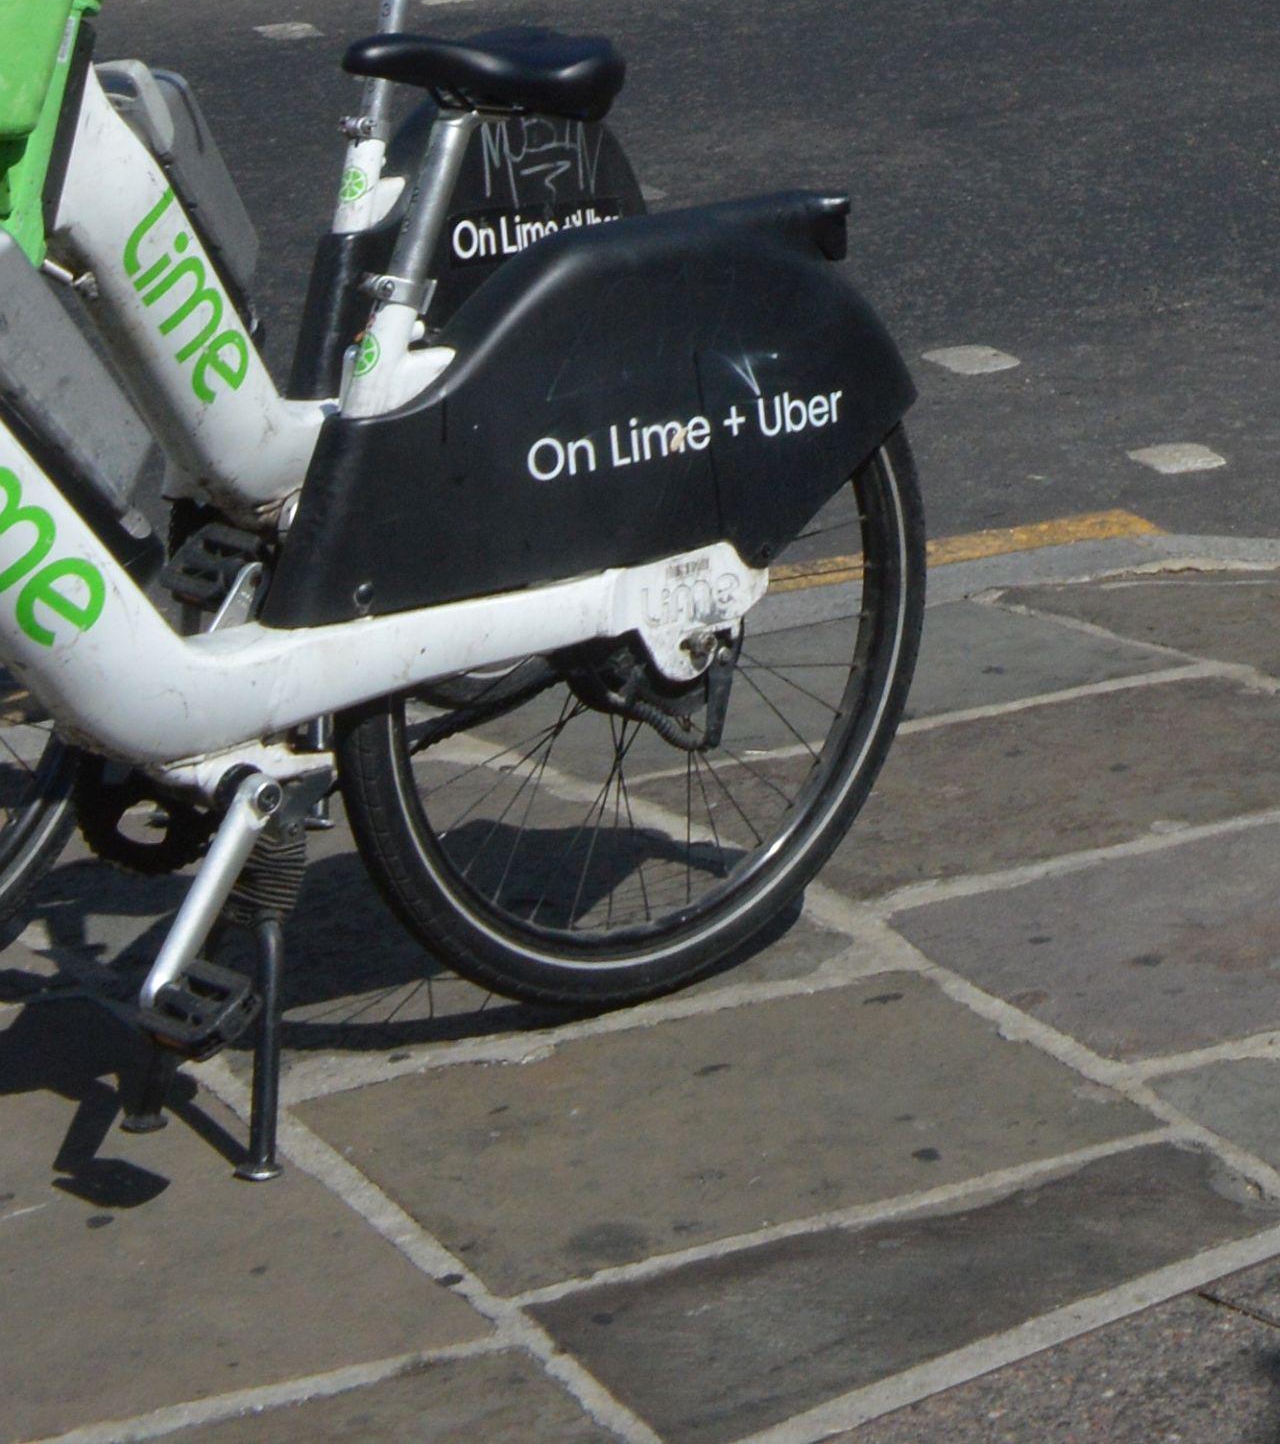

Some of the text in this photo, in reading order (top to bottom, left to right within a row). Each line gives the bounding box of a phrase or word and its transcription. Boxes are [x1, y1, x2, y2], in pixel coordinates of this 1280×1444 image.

[453, 219, 496, 259] On
[527, 437, 596, 481] On
[609, 416, 711, 468] Lime
[757, 390, 843, 437] Uber
[0, 465, 106, 648] me
